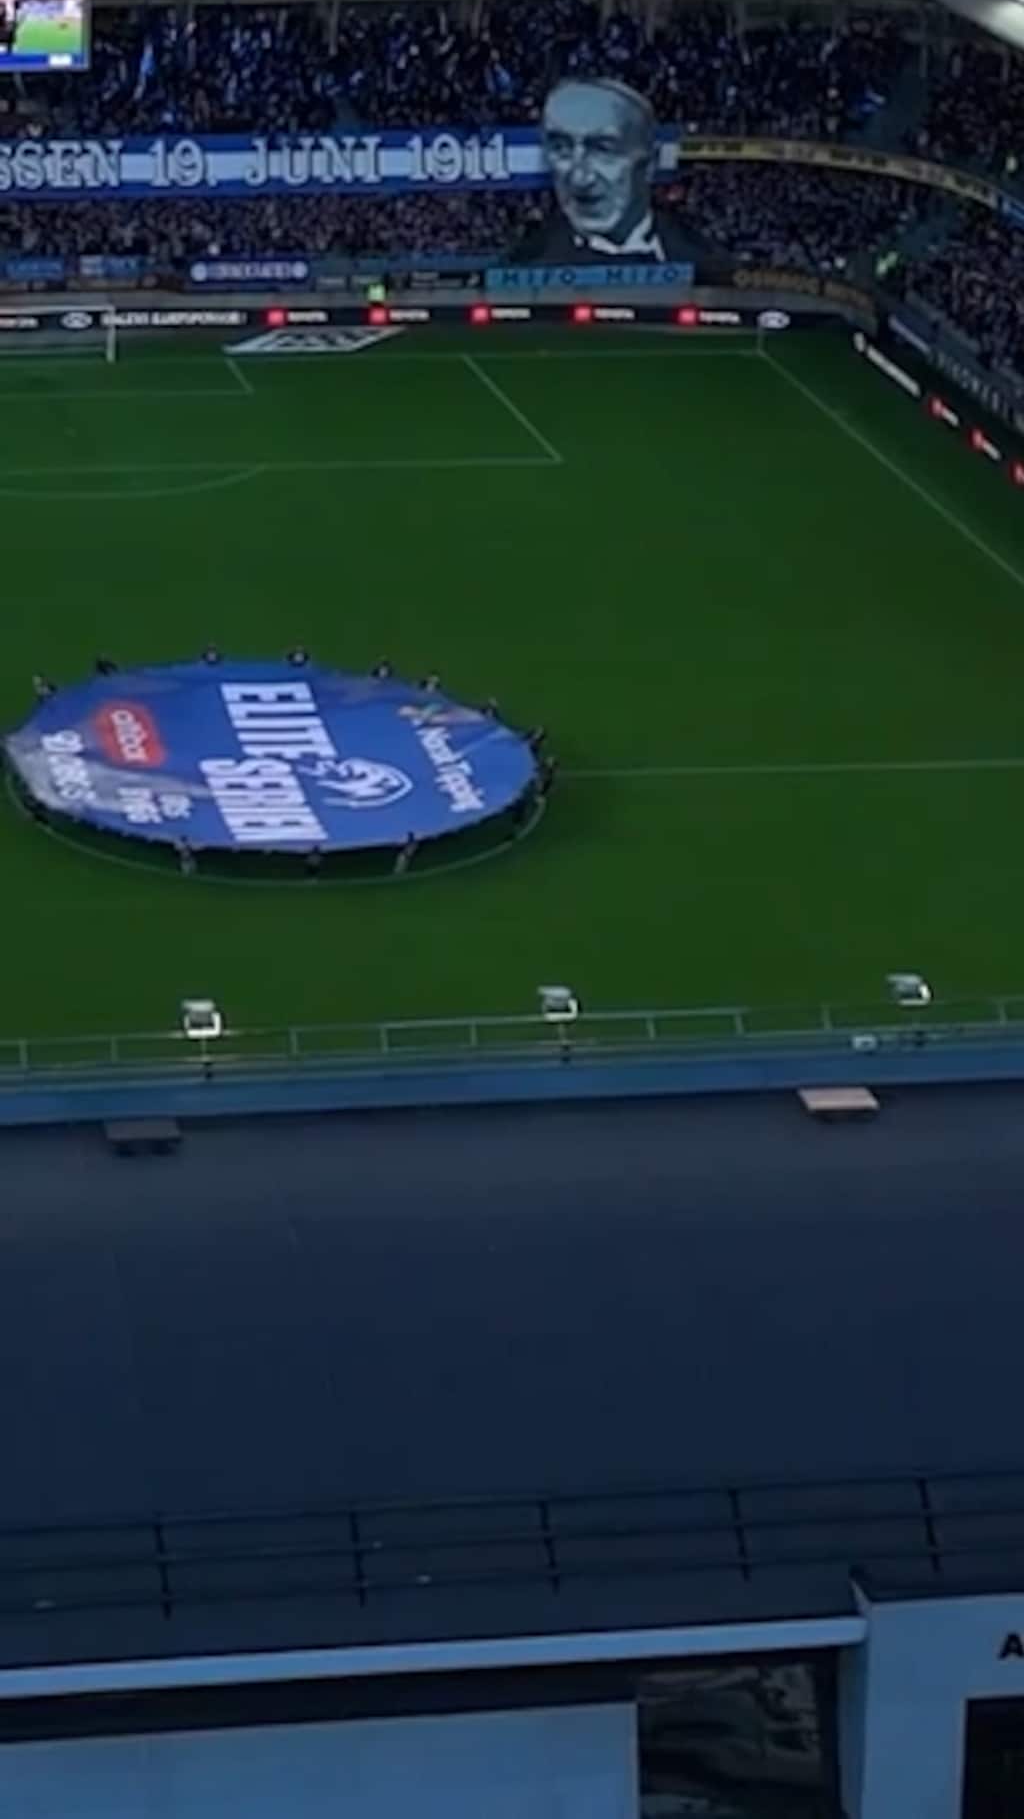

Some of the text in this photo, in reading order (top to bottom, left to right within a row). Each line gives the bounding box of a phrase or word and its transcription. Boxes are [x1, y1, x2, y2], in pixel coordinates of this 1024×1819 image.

[245, 135, 382, 186] JUNI
[407, 133, 509, 182] 1911
[220, 682, 338, 761] ELITE
